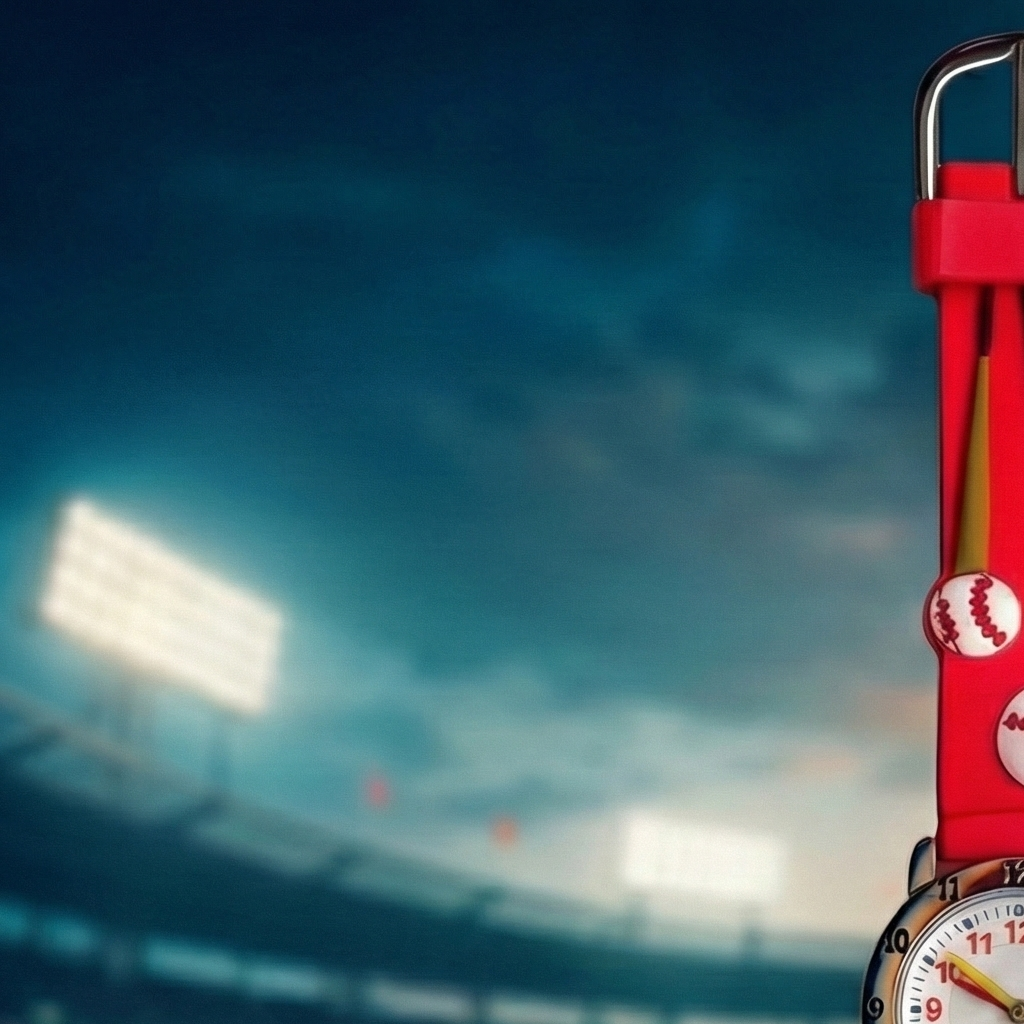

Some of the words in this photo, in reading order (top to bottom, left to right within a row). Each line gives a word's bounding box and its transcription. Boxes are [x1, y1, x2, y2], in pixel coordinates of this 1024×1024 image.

[938, 877, 958, 900] 11
[885, 928, 909, 953] 10
[966, 933, 992, 954] 11
[867, 997, 884, 1020] 9
[926, 997, 942, 1021] 9
